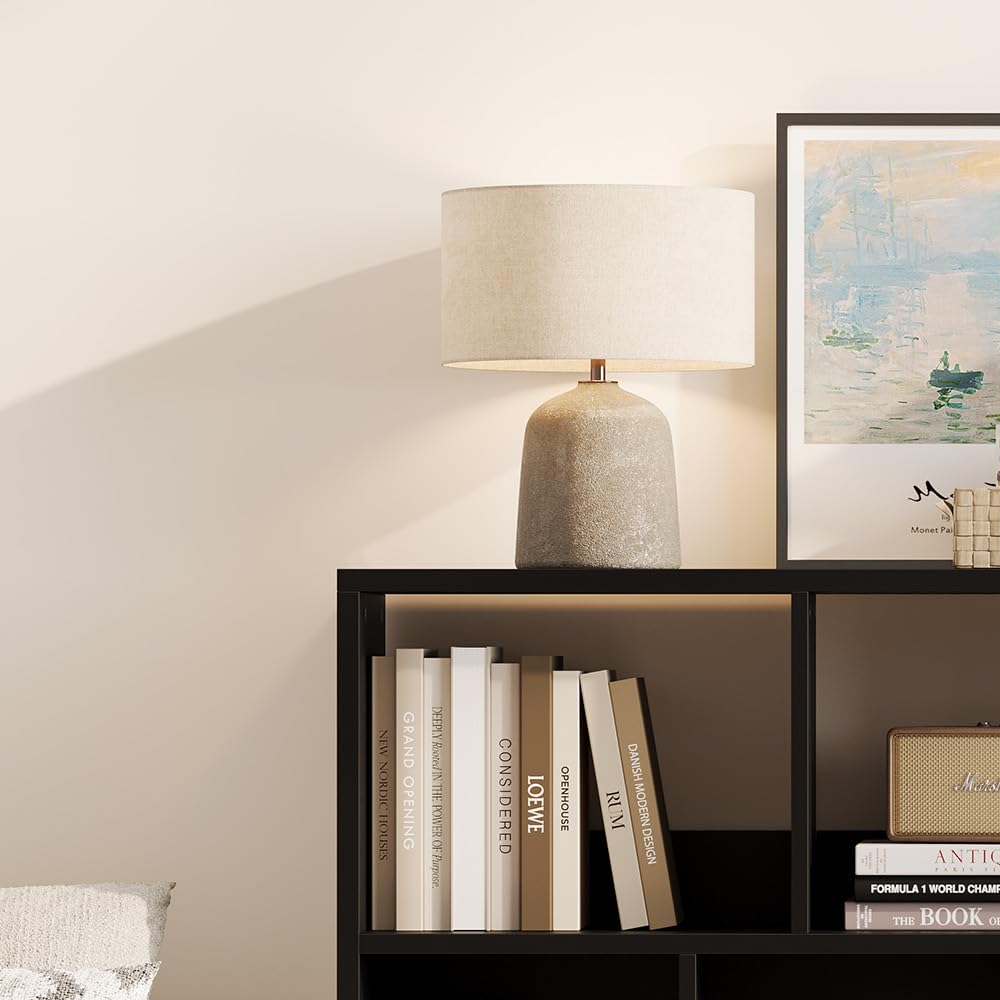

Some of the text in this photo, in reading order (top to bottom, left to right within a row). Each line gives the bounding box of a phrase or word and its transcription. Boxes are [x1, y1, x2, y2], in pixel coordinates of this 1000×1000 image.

[432, 707, 442, 740] DEEPLY
[432, 742, 442, 770] Rooted
[403, 712, 415, 850] GRAND OPENING
[432, 772, 442, 781] IN
[432, 783, 442, 801] THE
[379, 731, 388, 861] NEW NORDIC HOUSES
[499, 738, 512, 855] CONSIDERED
[527, 775, 544, 833] LOEWE
[561, 766, 569, 832] OPENHOUSE
[606, 791, 625, 830] RUM
[628, 743, 656, 865] DANISH MODERN DESIGN
[432, 805, 442, 837] POWER
[432, 840, 442, 852] OF
[871, 884, 919, 894] FORMULA
[921, 884, 926, 894] 1
[929, 884, 965, 894] WORLD
[893, 917, 915, 926] THE
[920, 907, 984, 926] BOOK
